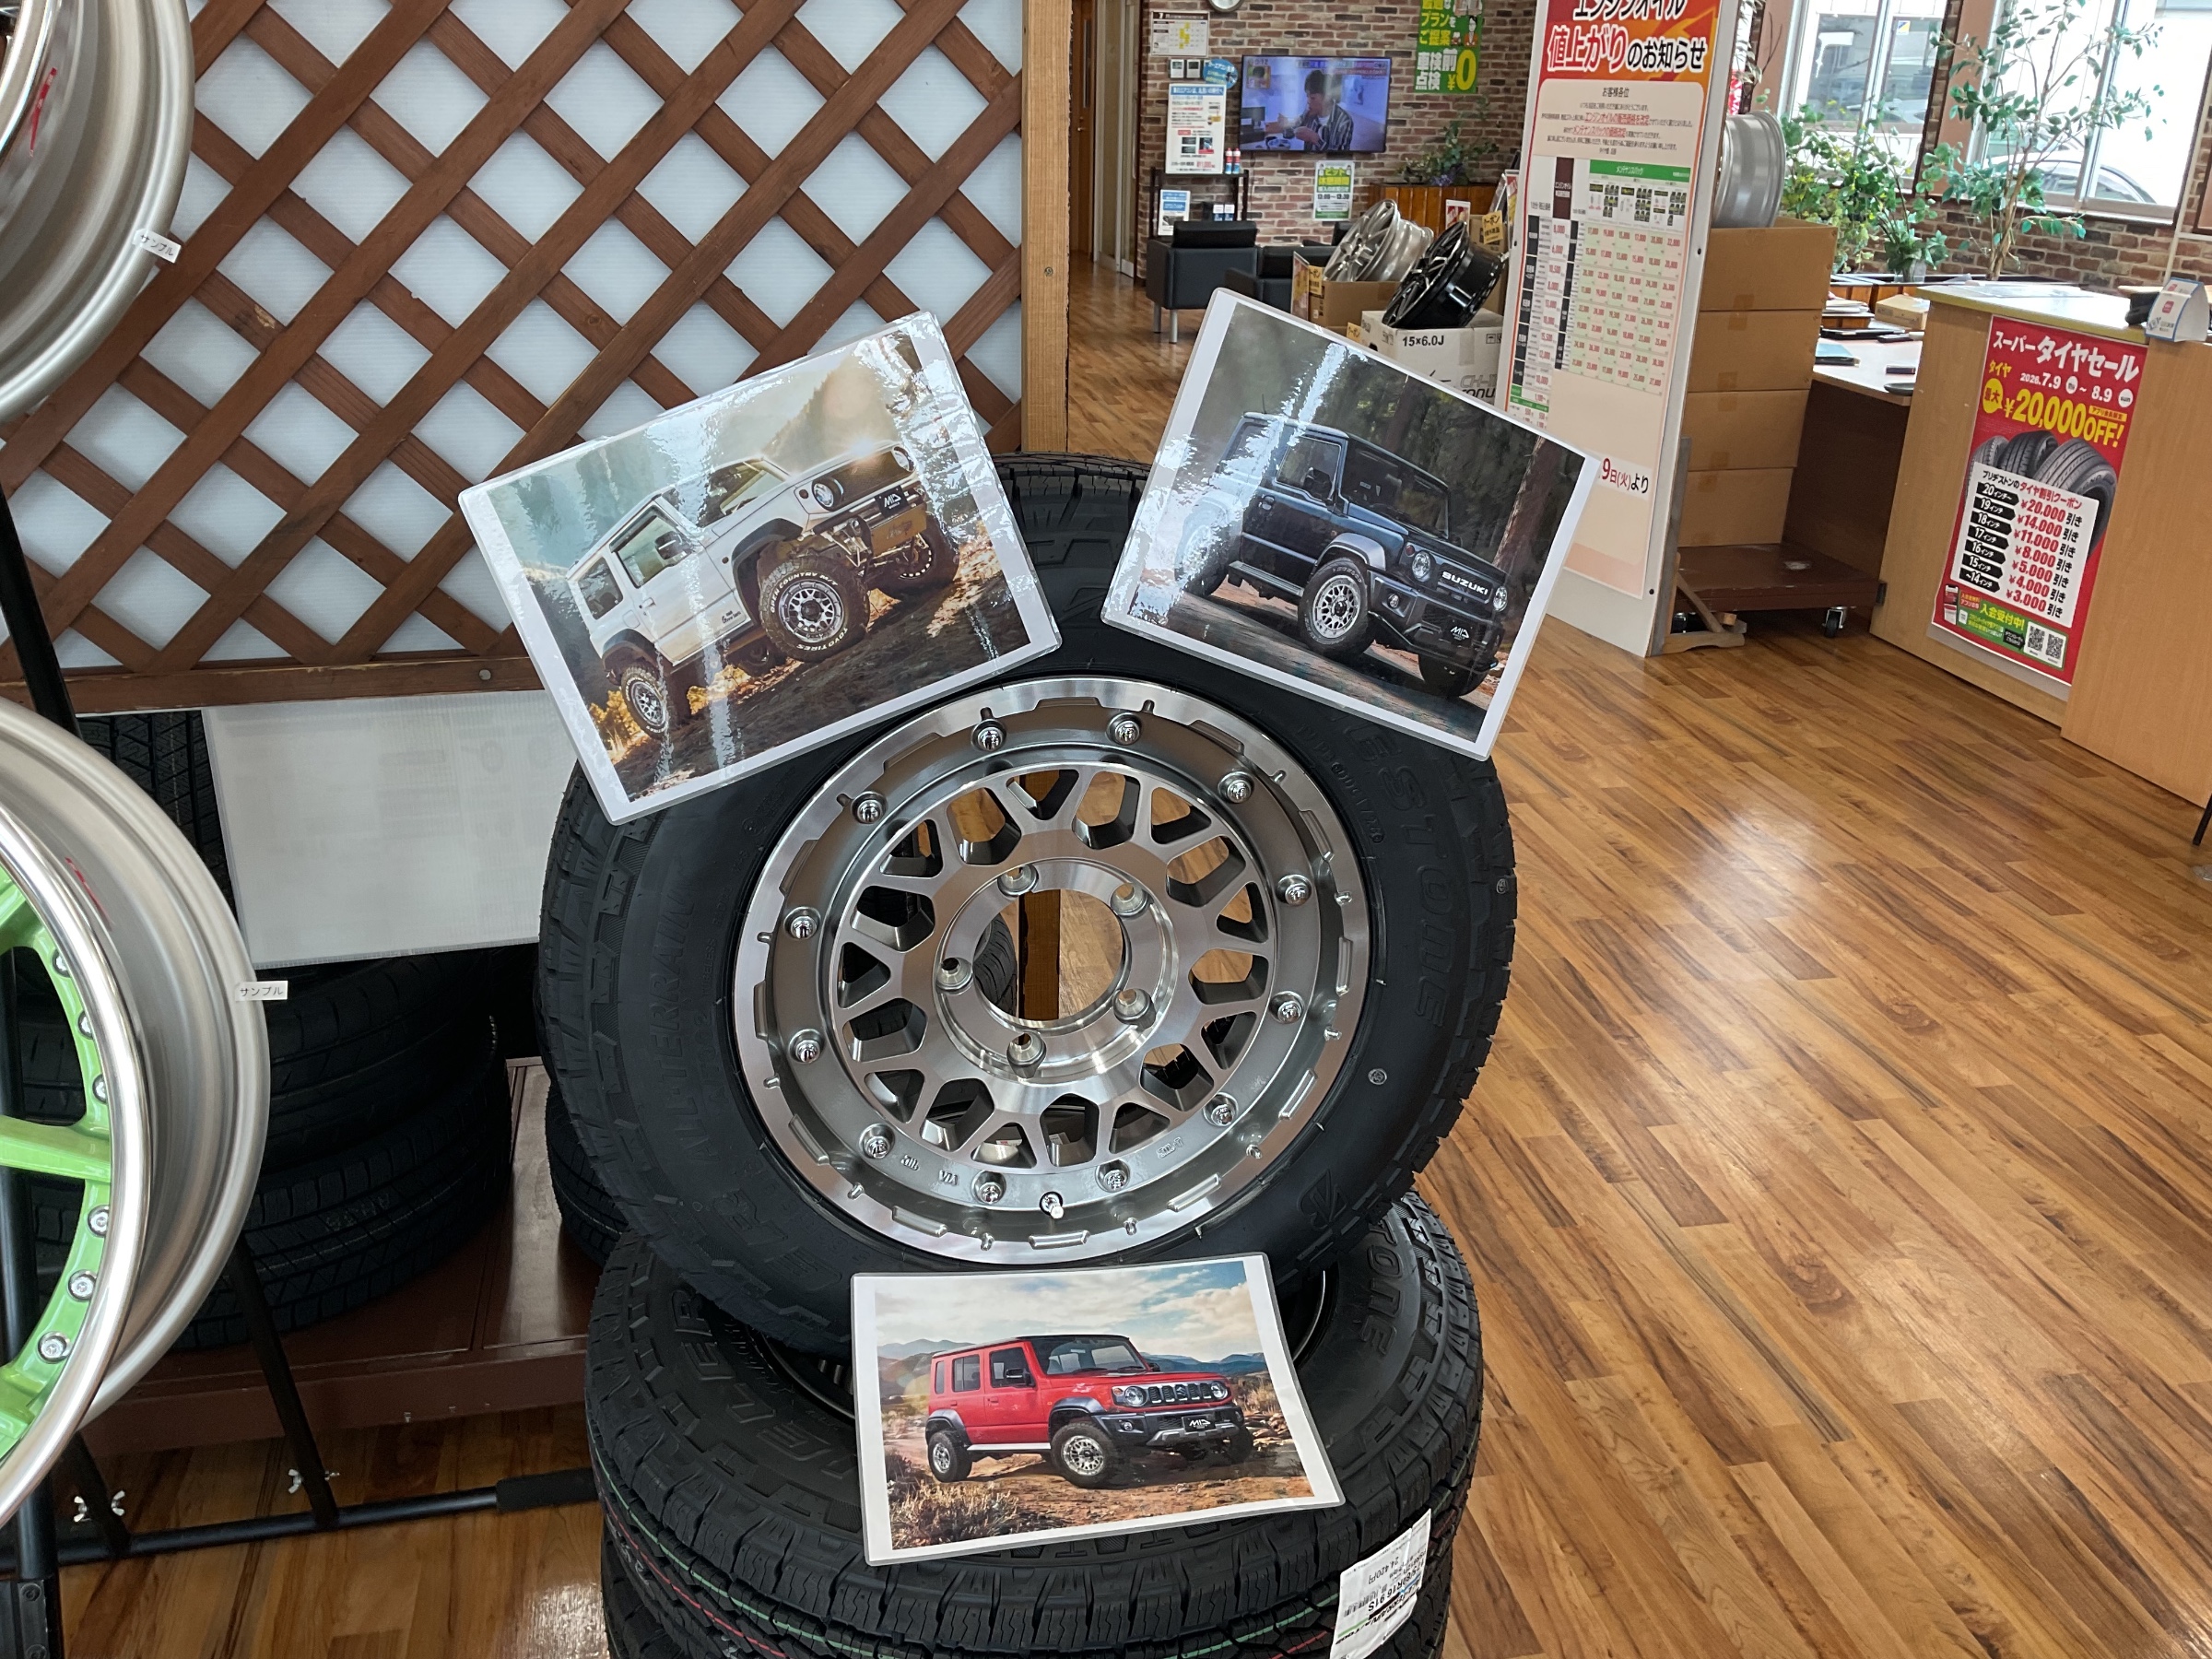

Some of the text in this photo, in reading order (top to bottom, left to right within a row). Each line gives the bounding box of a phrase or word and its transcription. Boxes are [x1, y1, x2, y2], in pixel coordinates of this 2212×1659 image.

[1421, 11, 1456, 28] プランを
[1419, 29, 1452, 46] ご提案
[1548, 26, 1707, 72] 値上がりのお知らせ
[1417, 48, 1458, 72] 車検前
[1416, 71, 1441, 90] 点検
[140, 234, 173, 255] サンプル
[1993, 331, 2139, 382] スーパータイヤセール
[1988, 359, 2012, 378] タイヤ
[1984, 387, 2000, 404] 最大
[2091, 385, 2112, 402] 8.9
[1981, 498, 2004, 514] 19インチ
[1977, 512, 2000, 529] 18インチ
[1975, 527, 1997, 543] 17インチ
[1972, 543, 1994, 558] 16インチ
[1970, 557, 1991, 572] 15インチ
[779, 571, 818, 589] COUNTRY
[1441, 571, 1488, 595] SUZUKI
[1980, 603, 2025, 630] 入会受付中!
[796, 628, 848, 652] TOYO TIRES
[240, 986, 283, 996] サンプル
[1368, 1594, 1385, 1612] 91S
